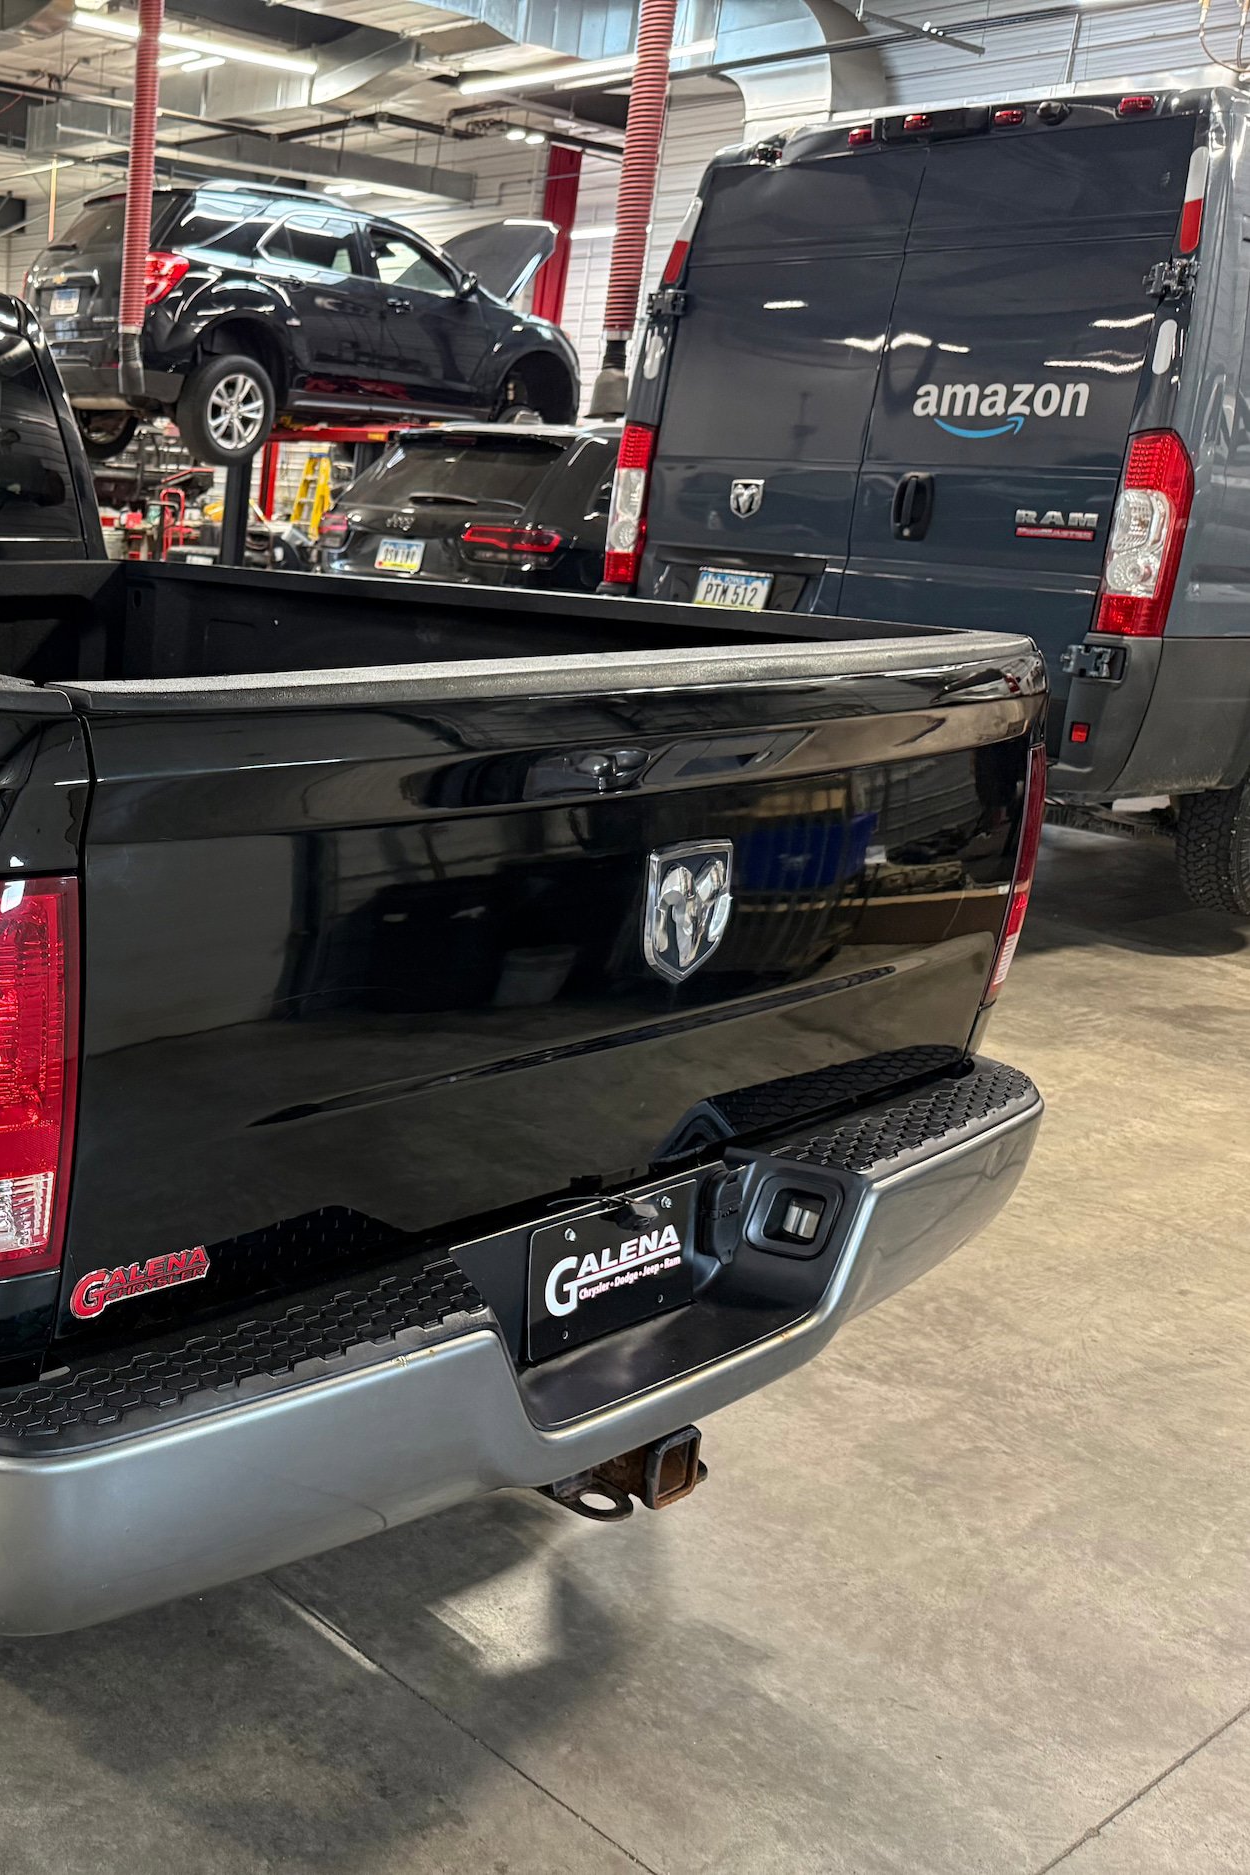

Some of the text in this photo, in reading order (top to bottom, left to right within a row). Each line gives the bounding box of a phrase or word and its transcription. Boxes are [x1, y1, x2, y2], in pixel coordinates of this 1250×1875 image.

[912, 382, 1090, 417] amazon
[1015, 509, 1099, 527] RAM
[730, 585, 758, 607] 512
[71, 1246, 209, 1317] GALENA
[105, 1267, 206, 1302] CHRYSLER
[544, 1224, 681, 1317] GALENA
